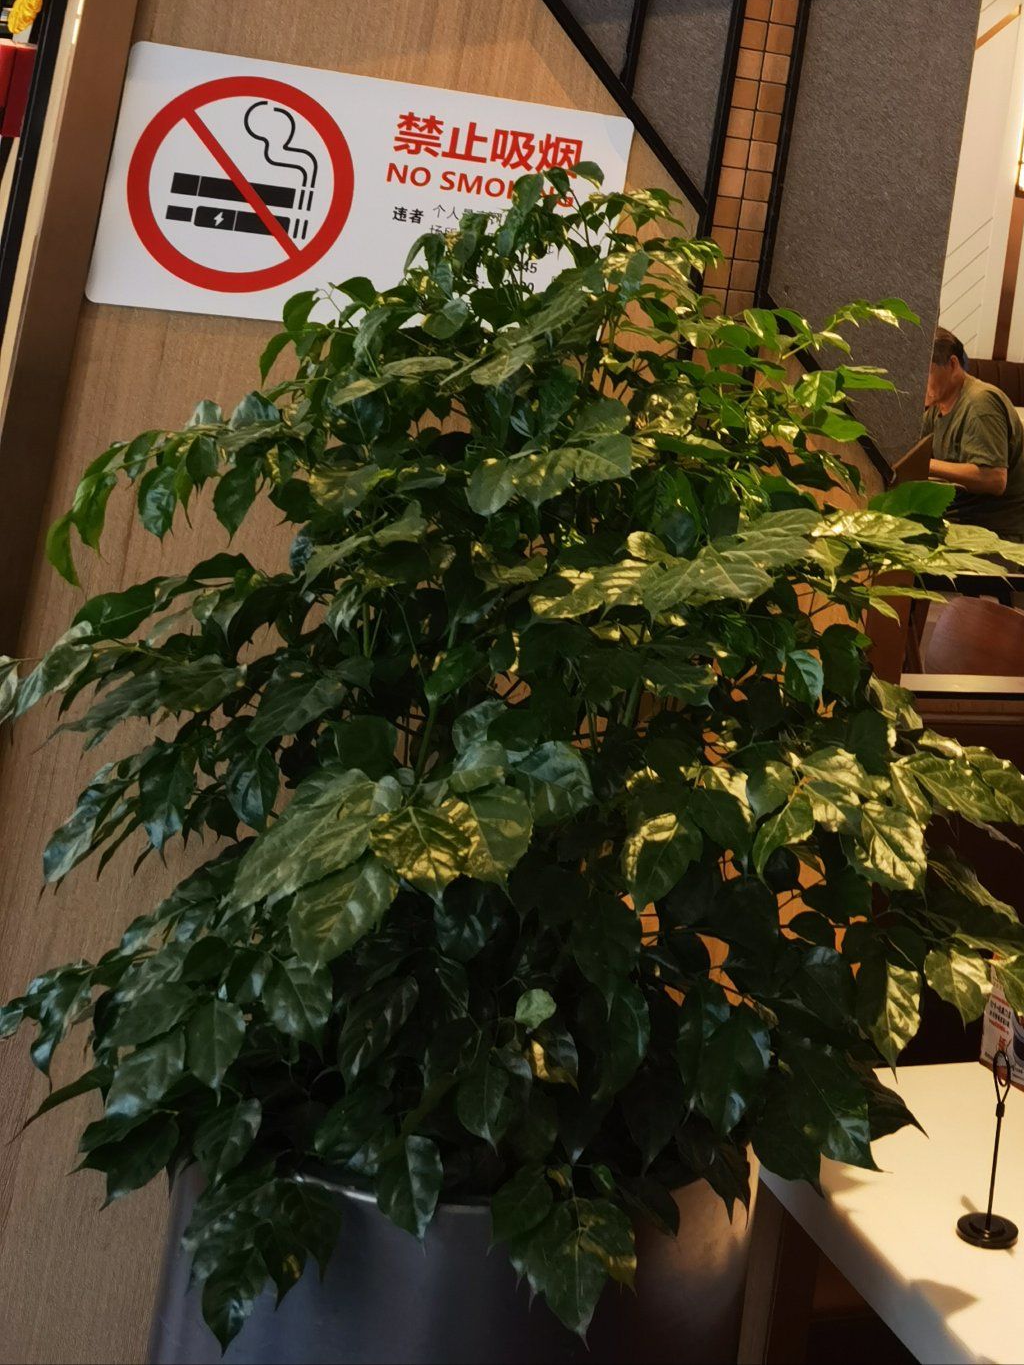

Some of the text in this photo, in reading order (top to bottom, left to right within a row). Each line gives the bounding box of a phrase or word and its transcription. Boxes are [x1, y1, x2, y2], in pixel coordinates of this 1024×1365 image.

[393, 111, 584, 179] 禁止吸烟
[386, 162, 432, 187] NO
[392, 206, 424, 225] 违者
